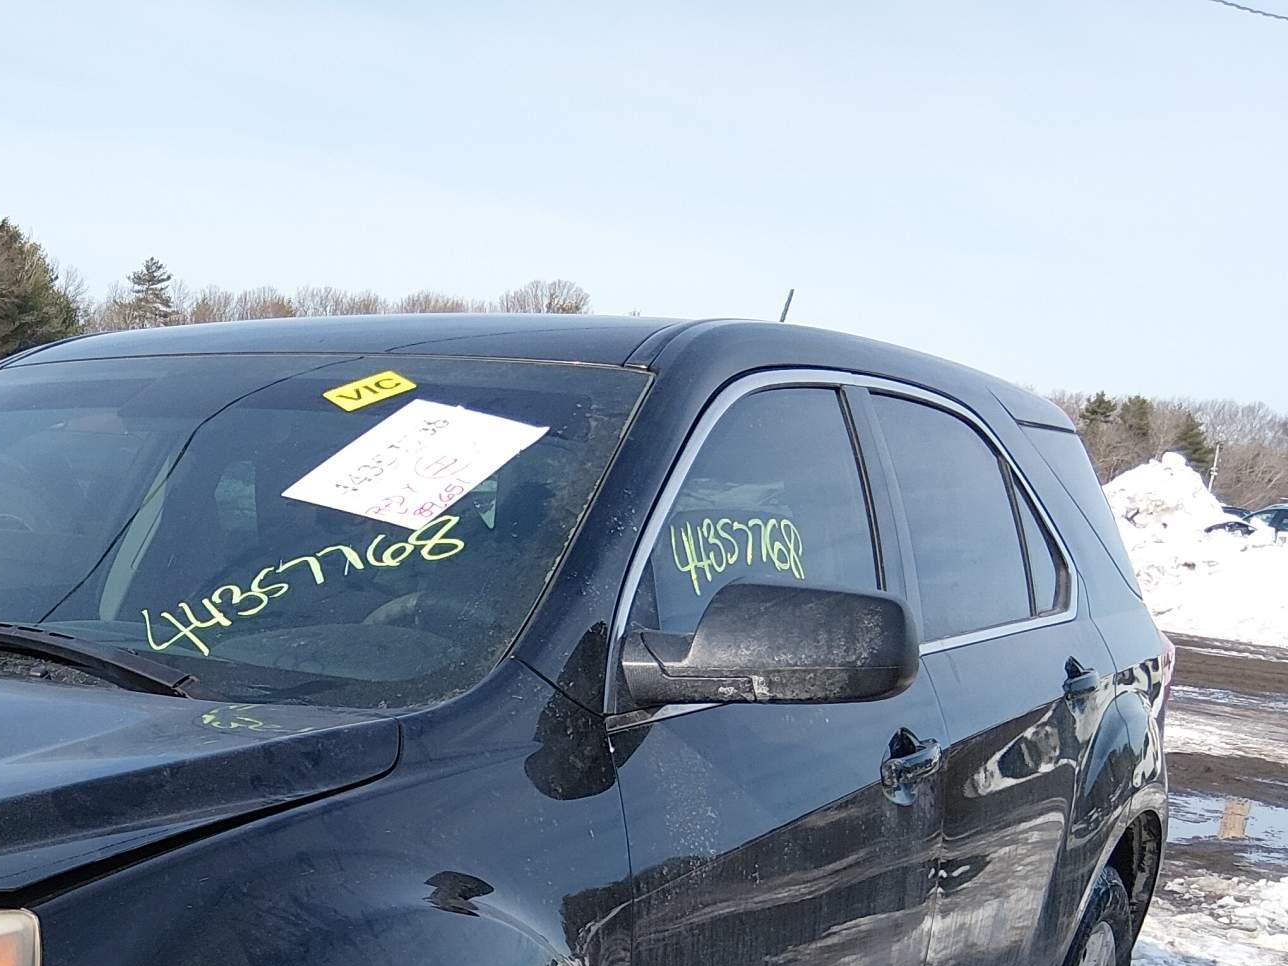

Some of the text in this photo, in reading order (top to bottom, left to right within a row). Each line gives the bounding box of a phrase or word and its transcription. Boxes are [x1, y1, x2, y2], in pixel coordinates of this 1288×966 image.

[335, 378, 402, 401] VIC
[141, 514, 465, 657] 44357768
[669, 517, 806, 596] 44357768
